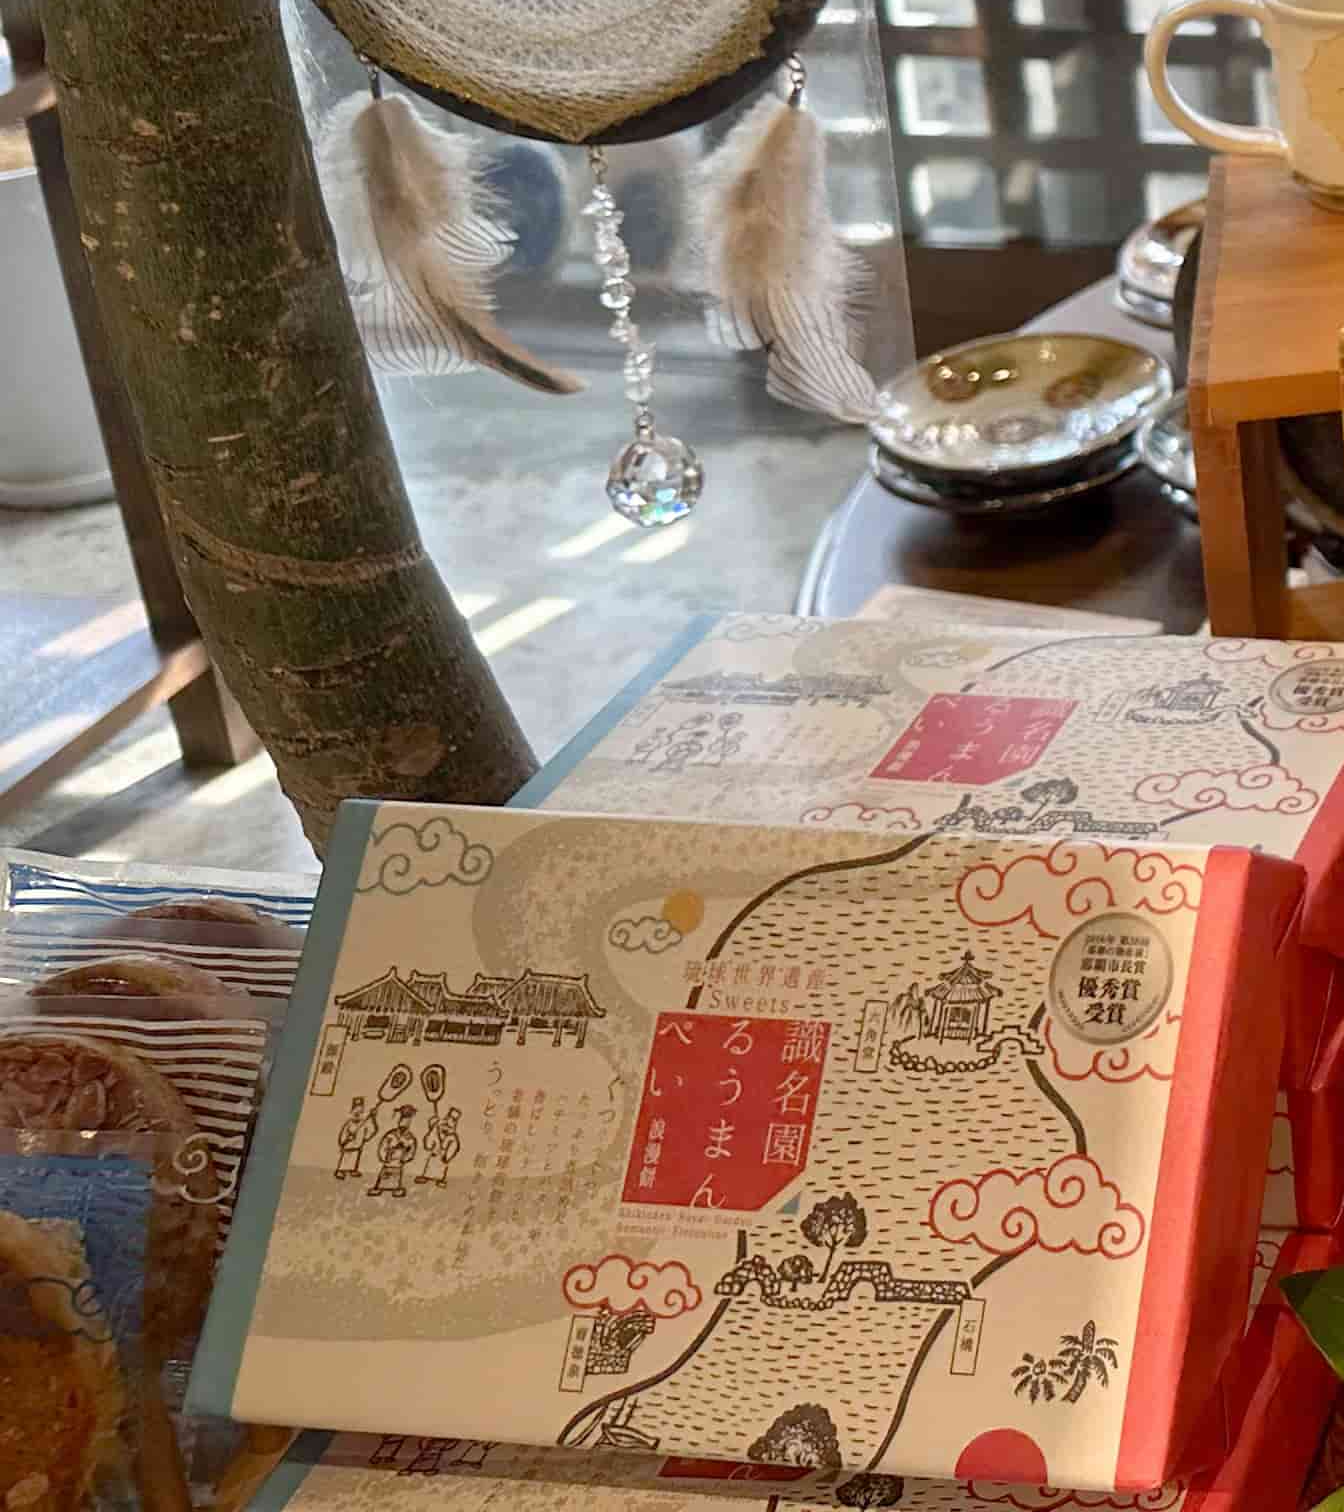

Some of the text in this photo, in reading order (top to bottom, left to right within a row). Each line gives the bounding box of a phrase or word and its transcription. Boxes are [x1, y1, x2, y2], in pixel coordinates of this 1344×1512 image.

[708, 988, 791, 1014] Sweets
[1077, 975, 1142, 1002] 優秀賞
[1083, 1002, 1129, 1026] 受賞
[762, 1021, 825, 1167] 識名園
[688, 1018, 754, 1210] るうまん
